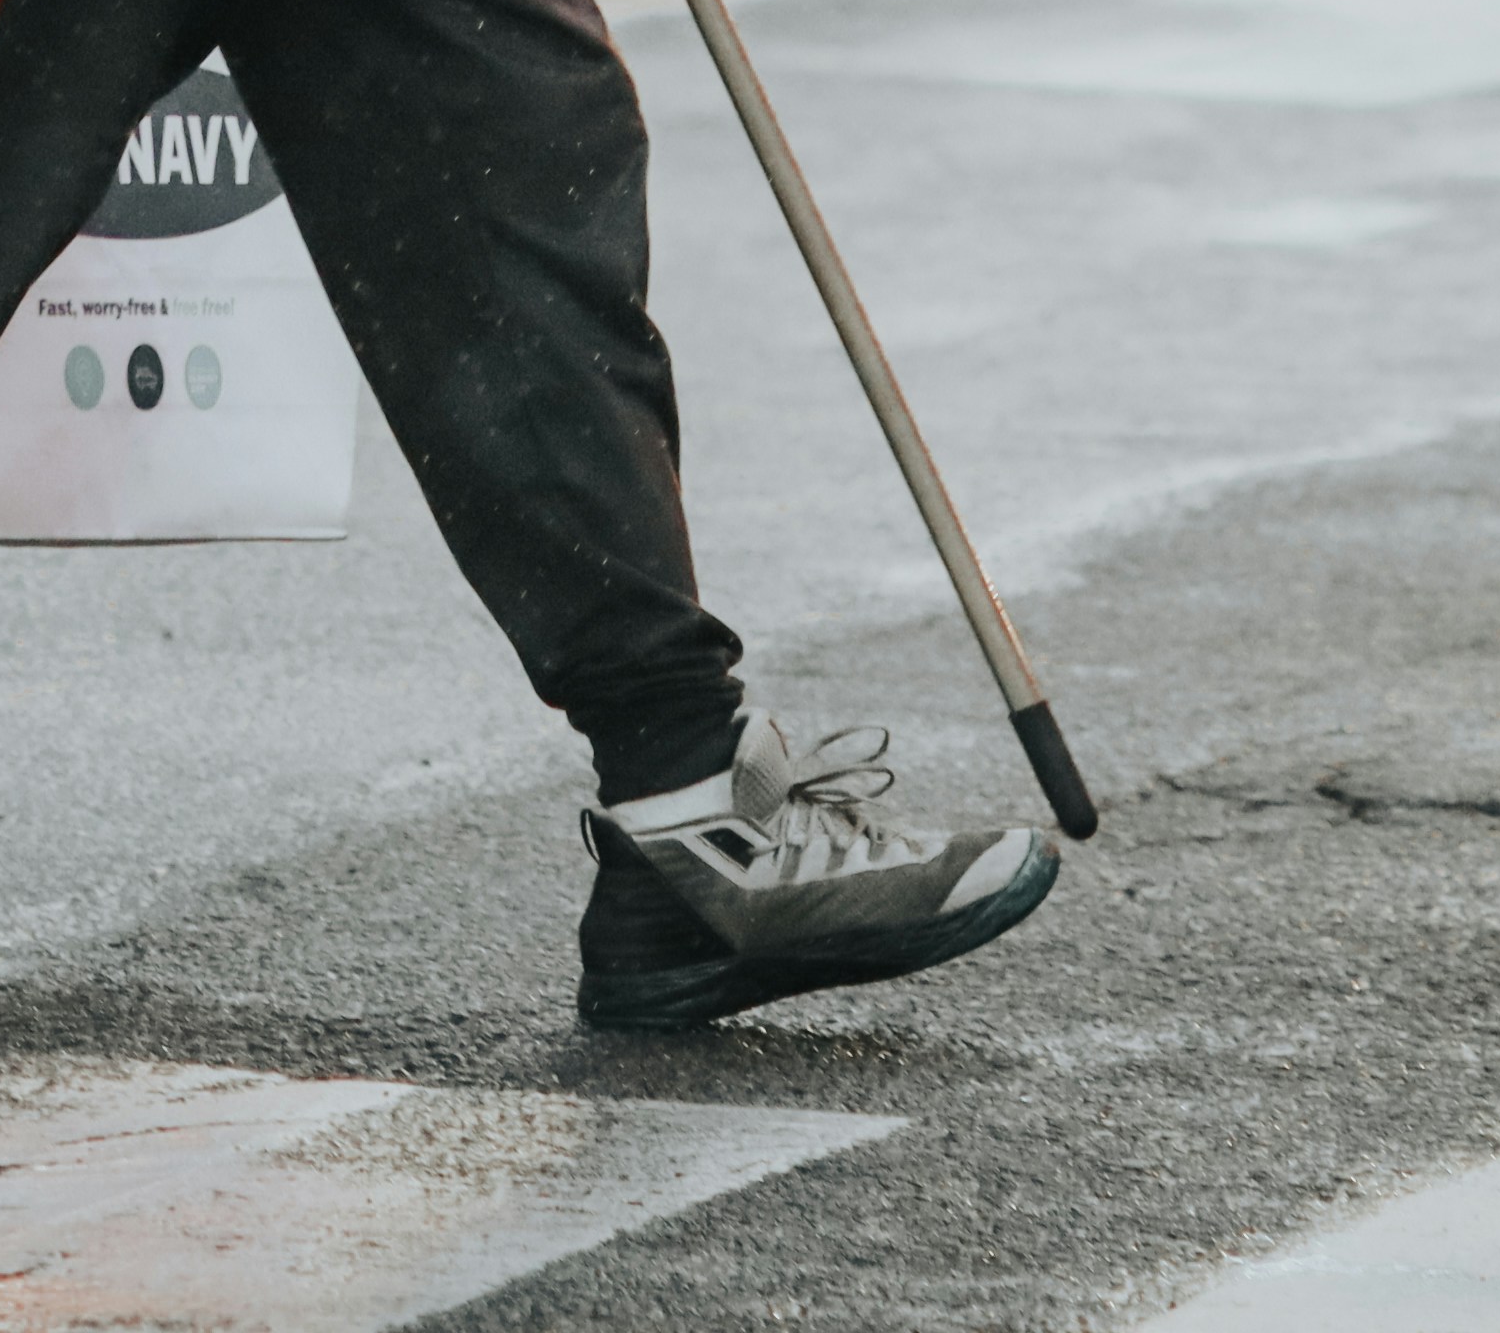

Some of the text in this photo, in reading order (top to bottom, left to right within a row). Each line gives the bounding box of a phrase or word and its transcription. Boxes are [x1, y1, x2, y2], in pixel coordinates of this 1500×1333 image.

[117, 114, 258, 185] NAVY
[38, 298, 77, 319] Fast,
[82, 297, 157, 320] worry-free
